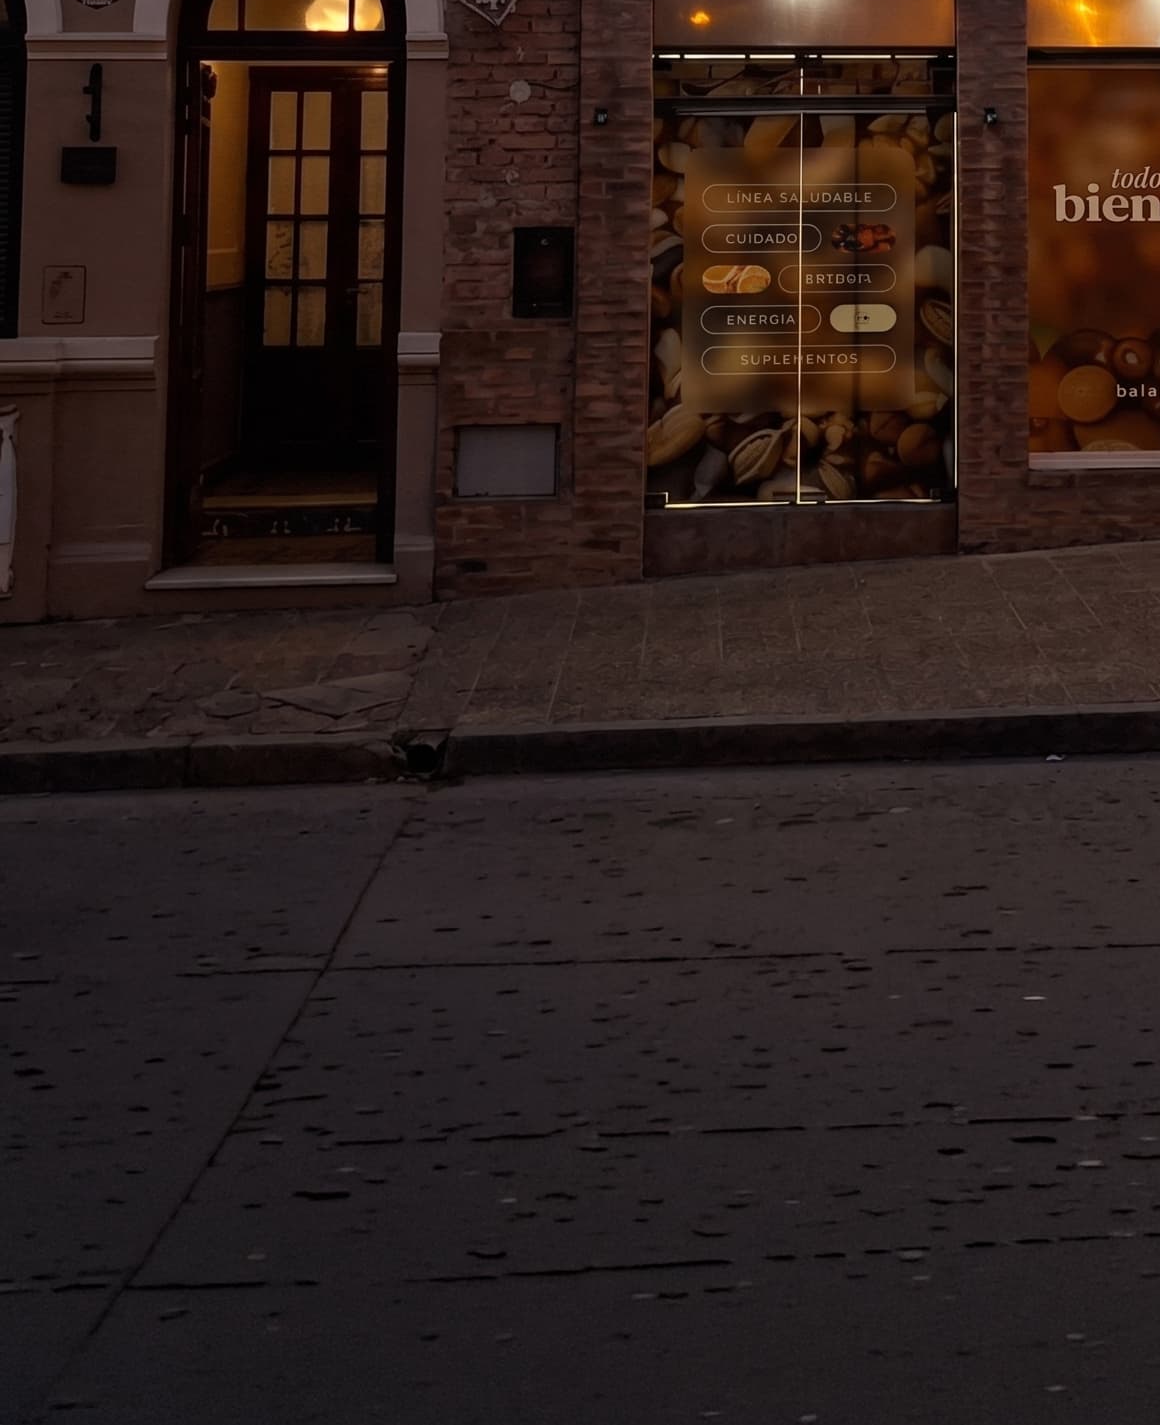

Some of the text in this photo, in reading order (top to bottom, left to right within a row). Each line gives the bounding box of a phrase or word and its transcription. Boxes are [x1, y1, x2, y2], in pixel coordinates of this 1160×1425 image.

[728, 190, 873, 204] LÍNEA SALUDABLE
[726, 234, 798, 245] CUIDADO
